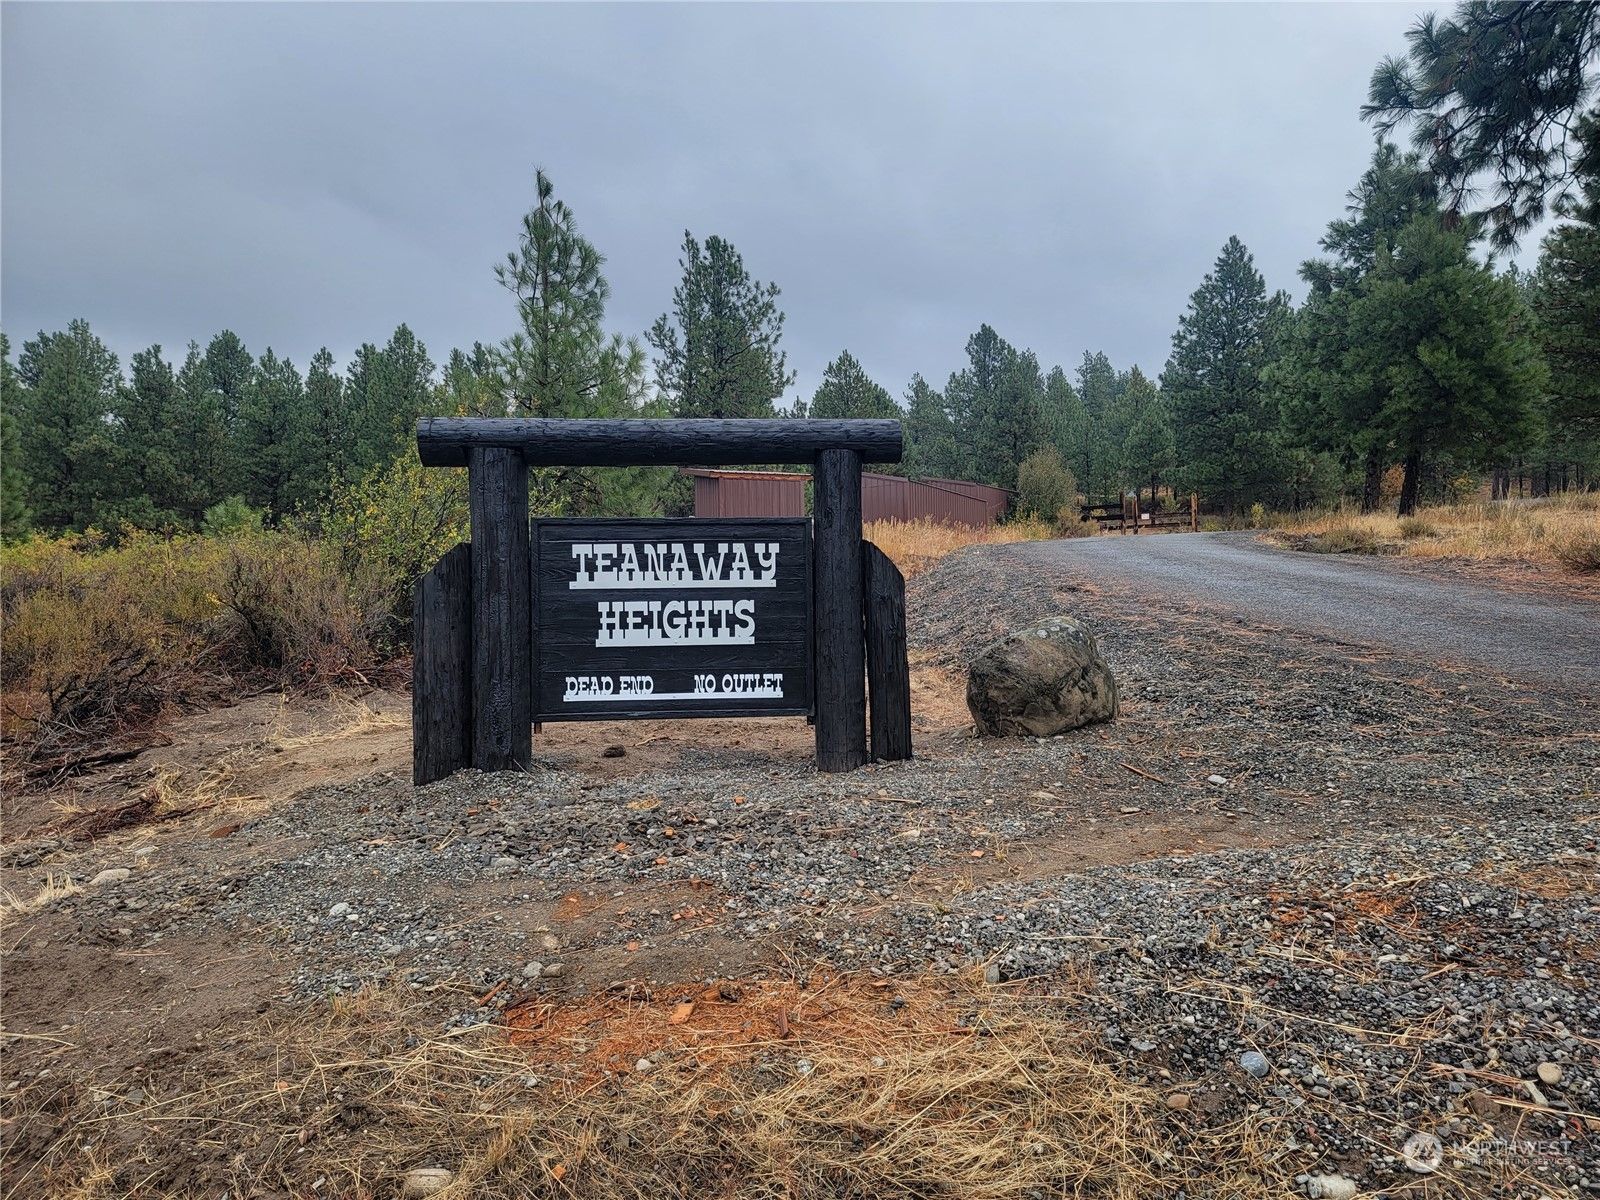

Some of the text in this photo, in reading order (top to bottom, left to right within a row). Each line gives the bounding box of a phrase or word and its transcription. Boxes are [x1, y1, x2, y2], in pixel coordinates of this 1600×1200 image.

[571, 543, 779, 585] TEANAWAY
[597, 600, 756, 642] HEIGHTS
[565, 673, 783, 697] DEAD END NO OUTLET
